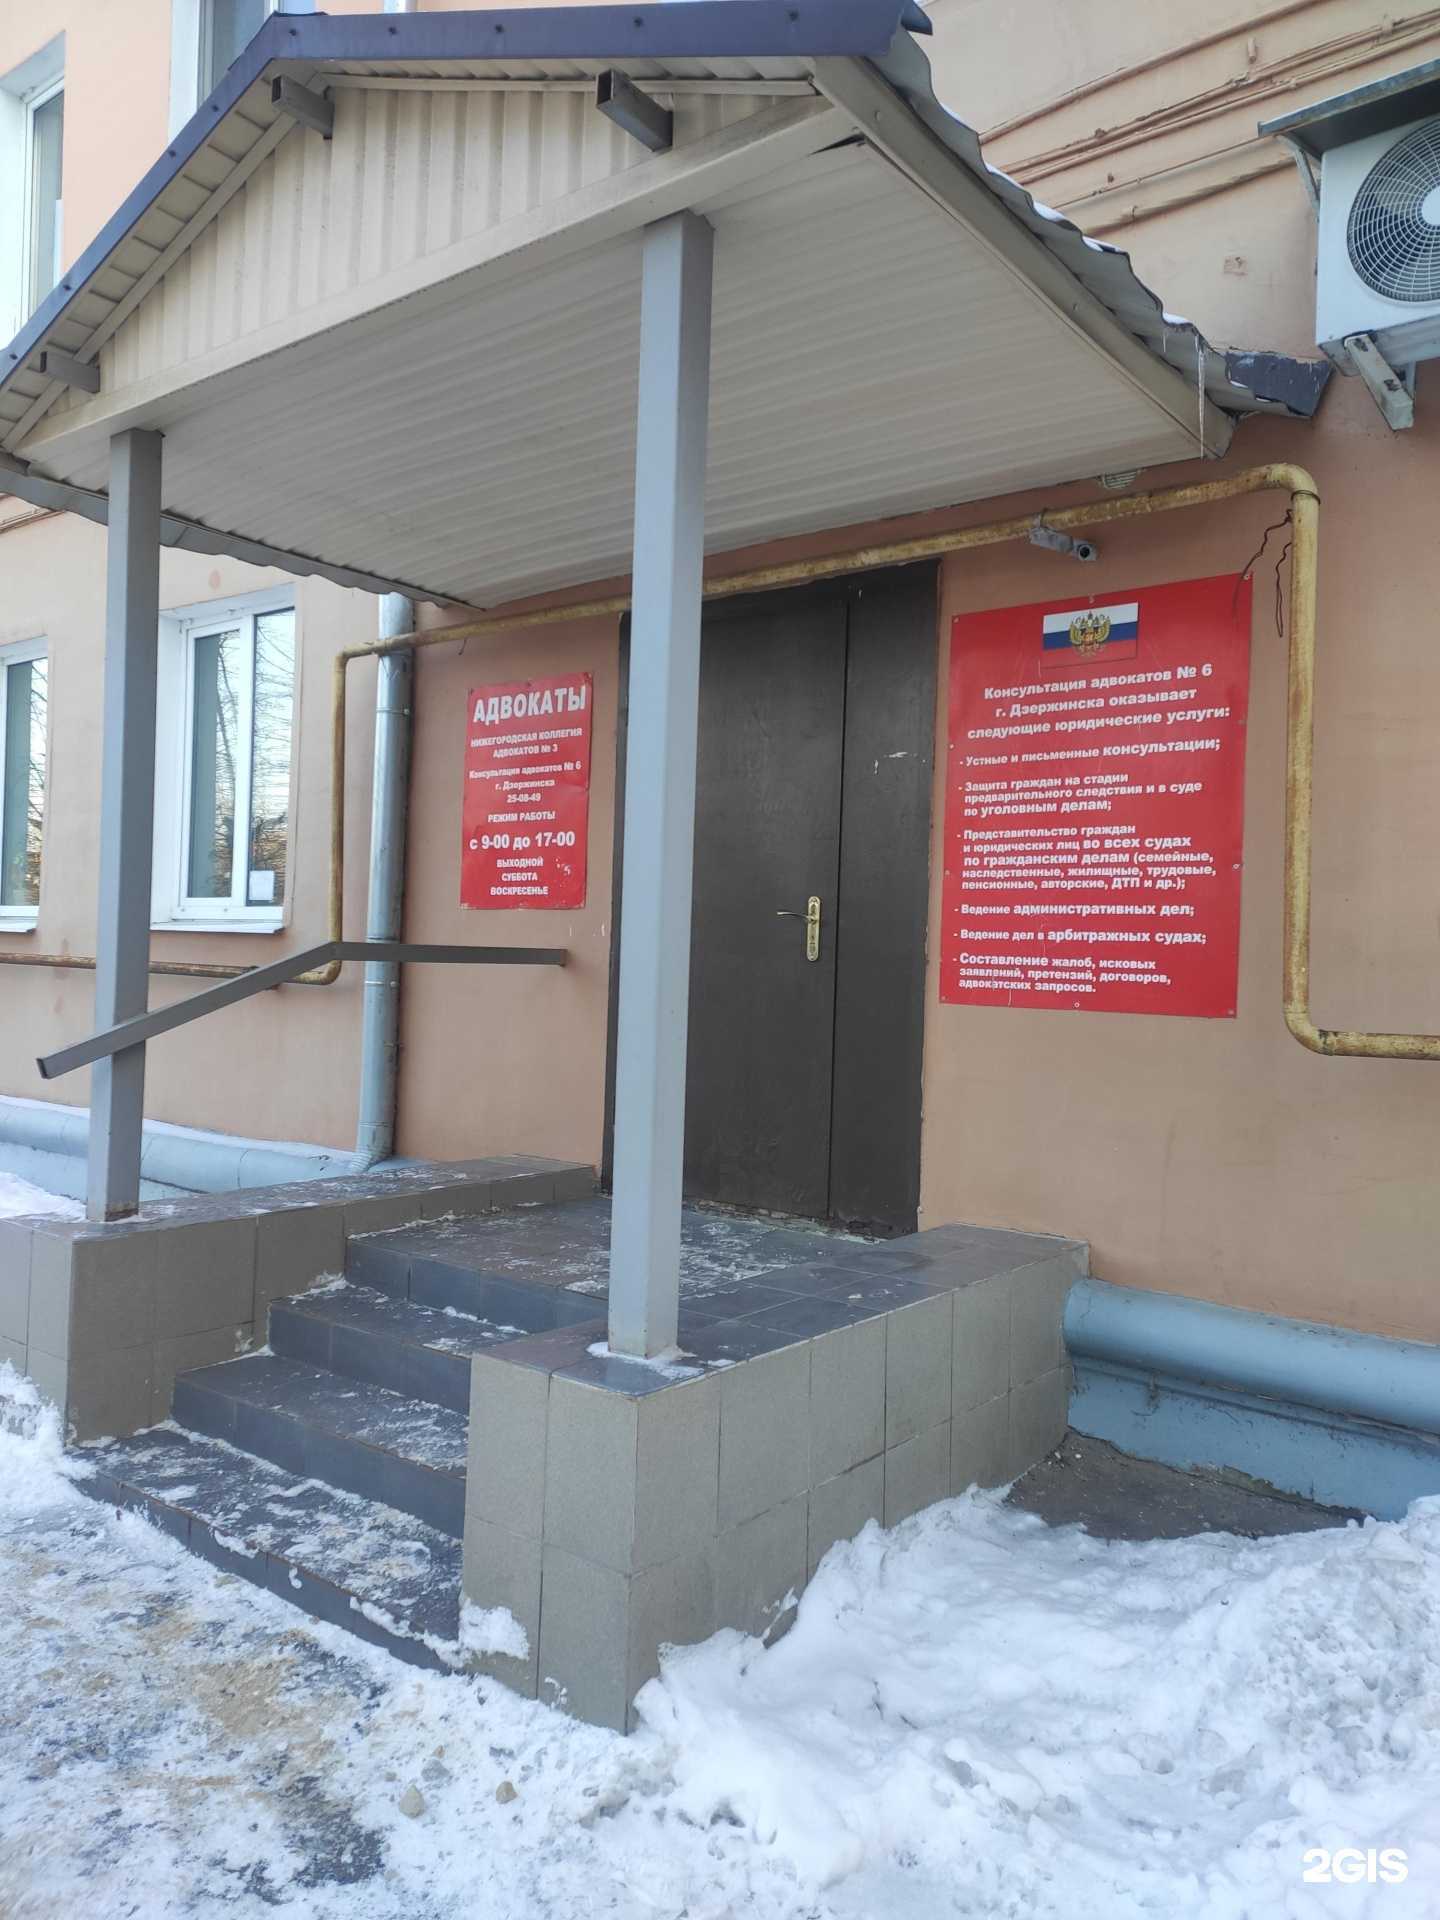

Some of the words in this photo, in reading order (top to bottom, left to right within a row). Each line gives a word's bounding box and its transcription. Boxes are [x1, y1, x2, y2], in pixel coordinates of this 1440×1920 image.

[984, 679, 1086, 700] Консультация
[1090, 670, 1171, 689] адвокатов
[1177, 666, 1196, 678] №
[1202, 664, 1212, 676] 6
[473, 685, 586, 725] АДВОКАТЫ
[996, 708, 1006, 718] г.
[1010, 699, 1104, 718] Дзержинска
[1109, 689, 1197, 706] оказывает
[968, 722, 1050, 740] следующие
[1055, 712, 1162, 732] юридические
[1167, 707, 1230, 724] услуги:
[470, 734, 538, 747] НИЖЕГОРОДСКАЯ
[538, 728, 582, 740] КОЛЛЕГИЯ
[493, 746, 540, 758] АДВОКАТОВ
[541, 745, 551, 753] №
[966, 754, 1008, 766] Устные
[1011, 753, 1018, 762] и
[1022, 747, 1100, 762] письменные
[1103, 738, 1220, 756] консультации;
[469, 767, 520, 779] Консультация
[521, 764, 562, 775] адвокатов
[564, 762, 574, 771] №
[576, 761, 581, 770] 6
[965, 780, 1007, 793] Защита
[1010, 776, 1061, 790] граждан
[1084, 772, 1128, 784] стадии
[964, 788, 1072, 804] предварительного
[1076, 785, 1142, 798] следствия
[1146, 785, 1155, 794] и
[1159, 784, 1166, 793] в
[1170, 781, 1202, 794] суде
[488, 813, 518, 823] РЕЖИМ
[520, 811, 555, 820] РАБОТЫ
[964, 806, 978, 817] по
[980, 802, 1058, 818] уголовным
[1061, 800, 1112, 812] делам;
[964, 827, 1077, 839] Представительство
[1081, 824, 1136, 836] граждан
[470, 839, 478, 849] с
[481, 834, 510, 850] 9-00
[513, 837, 530, 851] до
[535, 831, 575, 846] 17-00
[973, 841, 1052, 854] юридических
[1056, 840, 1080, 850] лиц
[1083, 838, 1100, 849] во
[1104, 838, 1139, 848] всех
[1144, 835, 1191, 849] судах
[496, 856, 544, 869] ВЫХОДНОЙ
[984, 853, 1077, 868] гражданским
[1082, 852, 1130, 864] делам
[1134, 851, 1214, 865] (семейные,
[502, 872, 538, 882] СУББОТА
[962, 867, 1065, 879] наследственные,
[1068, 866, 1143, 878] жилищные,
[1147, 865, 1216, 877] трудовые,
[490, 886, 548, 896] ВОСКРЕСЕНЬЕ
[962, 878, 1038, 890] пенсионные,
[1041, 878, 1108, 889] авторские,
[1111, 877, 1140, 889] ДТП
[1143, 879, 1152, 887] и
[1156, 877, 1185, 889] др.);
[961, 904, 1010, 914] Ведение
[1014, 903, 1155, 916] административных
[1159, 904, 1195, 917] дел;
[960, 930, 1009, 939] Ведение
[1012, 931, 1034, 941] дел
[1037, 932, 1044, 940] в
[1048, 929, 1150, 943] арбитражных
[1155, 931, 1207, 945] судах;
[960, 953, 1048, 967] Составление
[1052, 956, 1096, 969] жалоб,
[1099, 959, 1156, 969] исковых
[959, 967, 1024, 979] заявлений,
[1028, 968, 1097, 981] претензий,
[1100, 972, 1171, 984] договоров,
[959, 978, 1031, 990] адвокатских
[1034, 980, 1096, 993] запросов.
